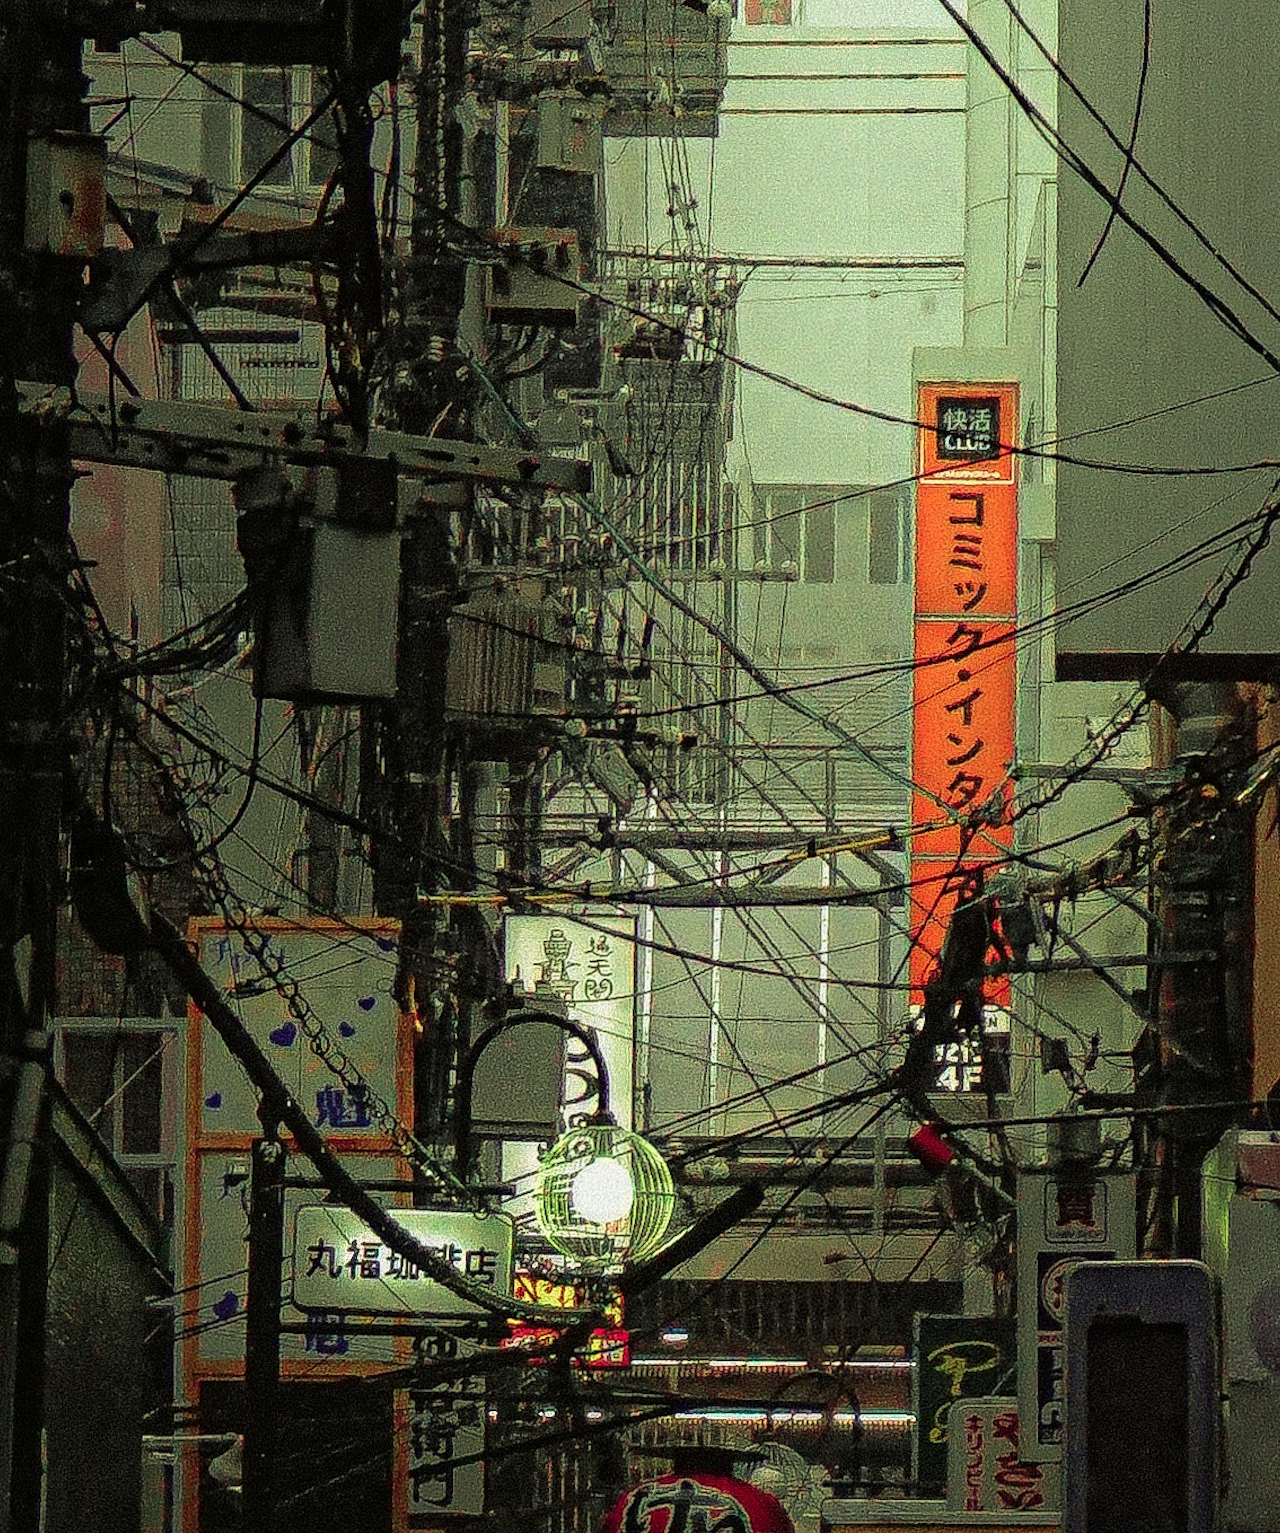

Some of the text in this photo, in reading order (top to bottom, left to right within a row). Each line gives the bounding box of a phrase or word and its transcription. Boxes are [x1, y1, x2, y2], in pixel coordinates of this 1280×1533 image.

[946, 491, 984, 897] コミック・インタ
[306, 1238, 499, 1285] 丸福珈店
